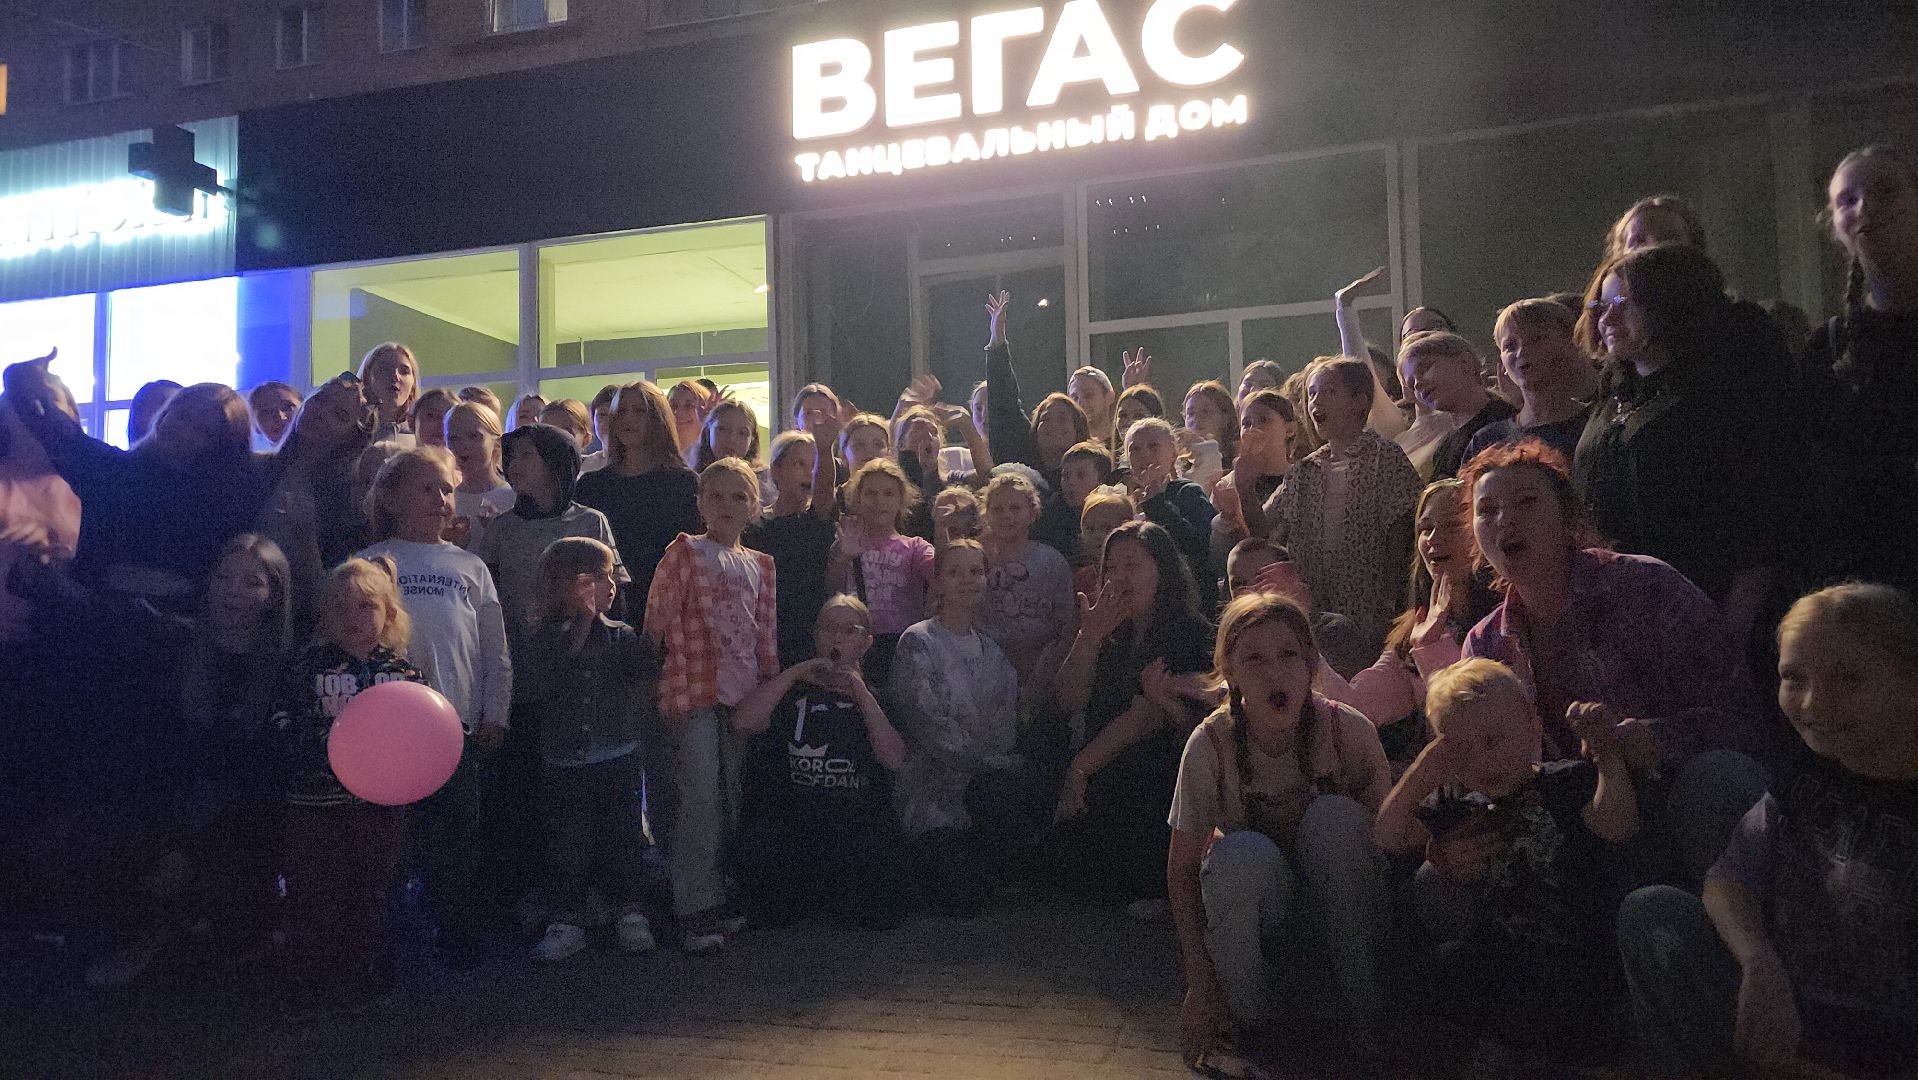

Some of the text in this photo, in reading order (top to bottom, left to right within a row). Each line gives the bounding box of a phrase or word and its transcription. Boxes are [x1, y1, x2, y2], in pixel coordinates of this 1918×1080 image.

[791, 0, 1245, 140] ВЕГАС
[794, 95, 1248, 182] ТАНЦЕВАЛЬНЫЙ ДОМ
